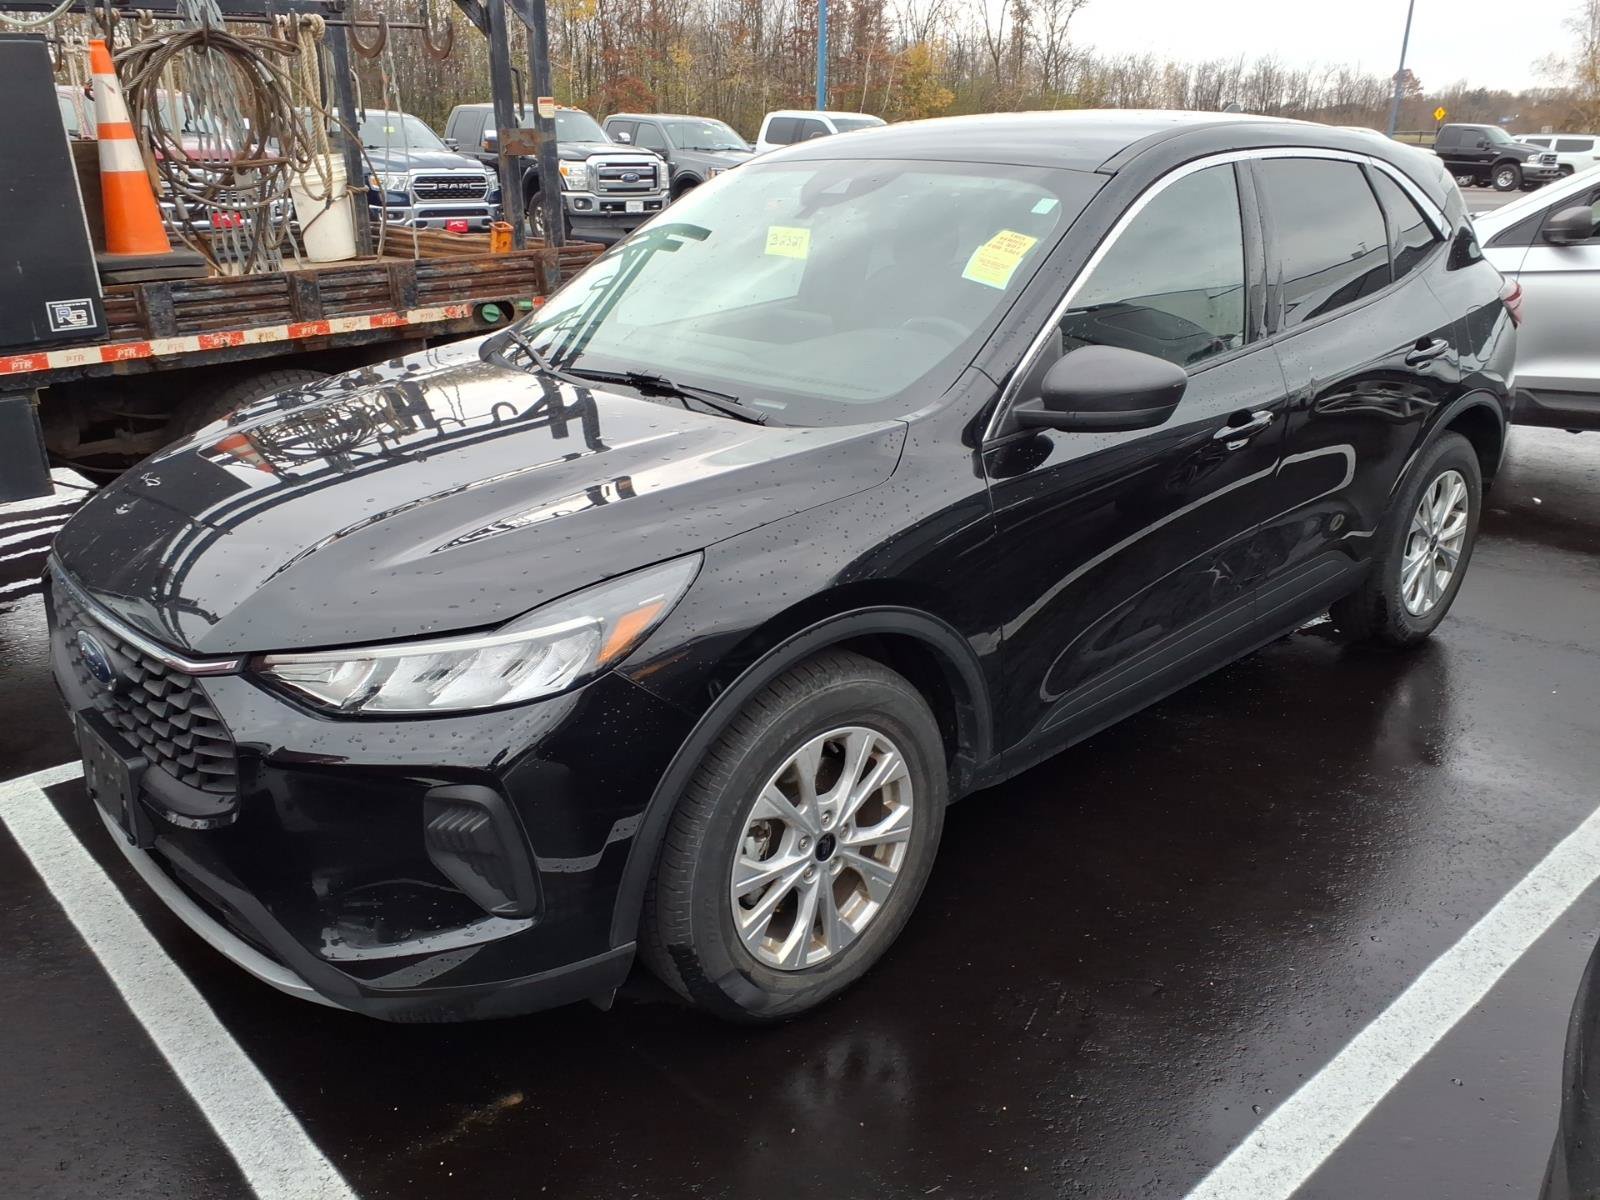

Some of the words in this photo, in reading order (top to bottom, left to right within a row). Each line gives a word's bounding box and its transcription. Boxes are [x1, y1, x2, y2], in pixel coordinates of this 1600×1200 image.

[11, 360, 32, 371] PTR
[116, 347, 137, 358] PTR
[382, 316, 397, 325] PTR
